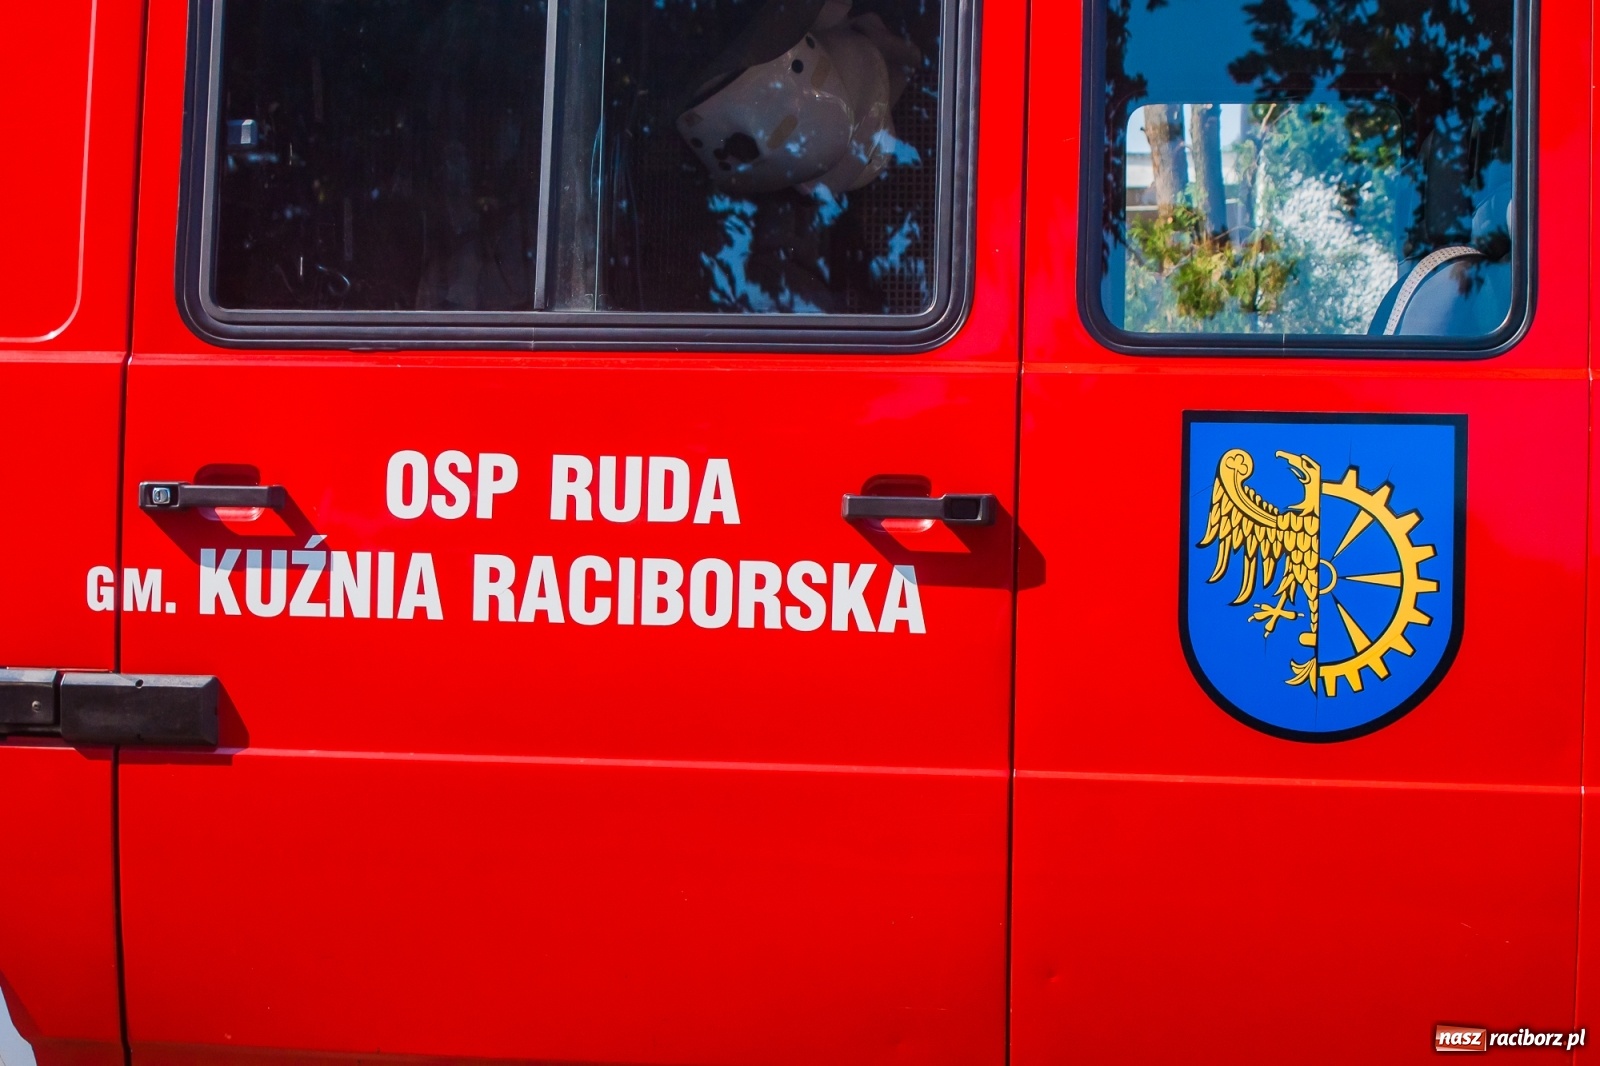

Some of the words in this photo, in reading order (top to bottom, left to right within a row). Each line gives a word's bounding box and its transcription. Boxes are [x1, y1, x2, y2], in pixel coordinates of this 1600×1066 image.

[386, 449, 519, 520] OSP
[549, 454, 741, 525] RUDA
[86, 565, 177, 614] GM.
[199, 534, 443, 621] KUŹNIA
[472, 553, 927, 635] RACIBORSKA
